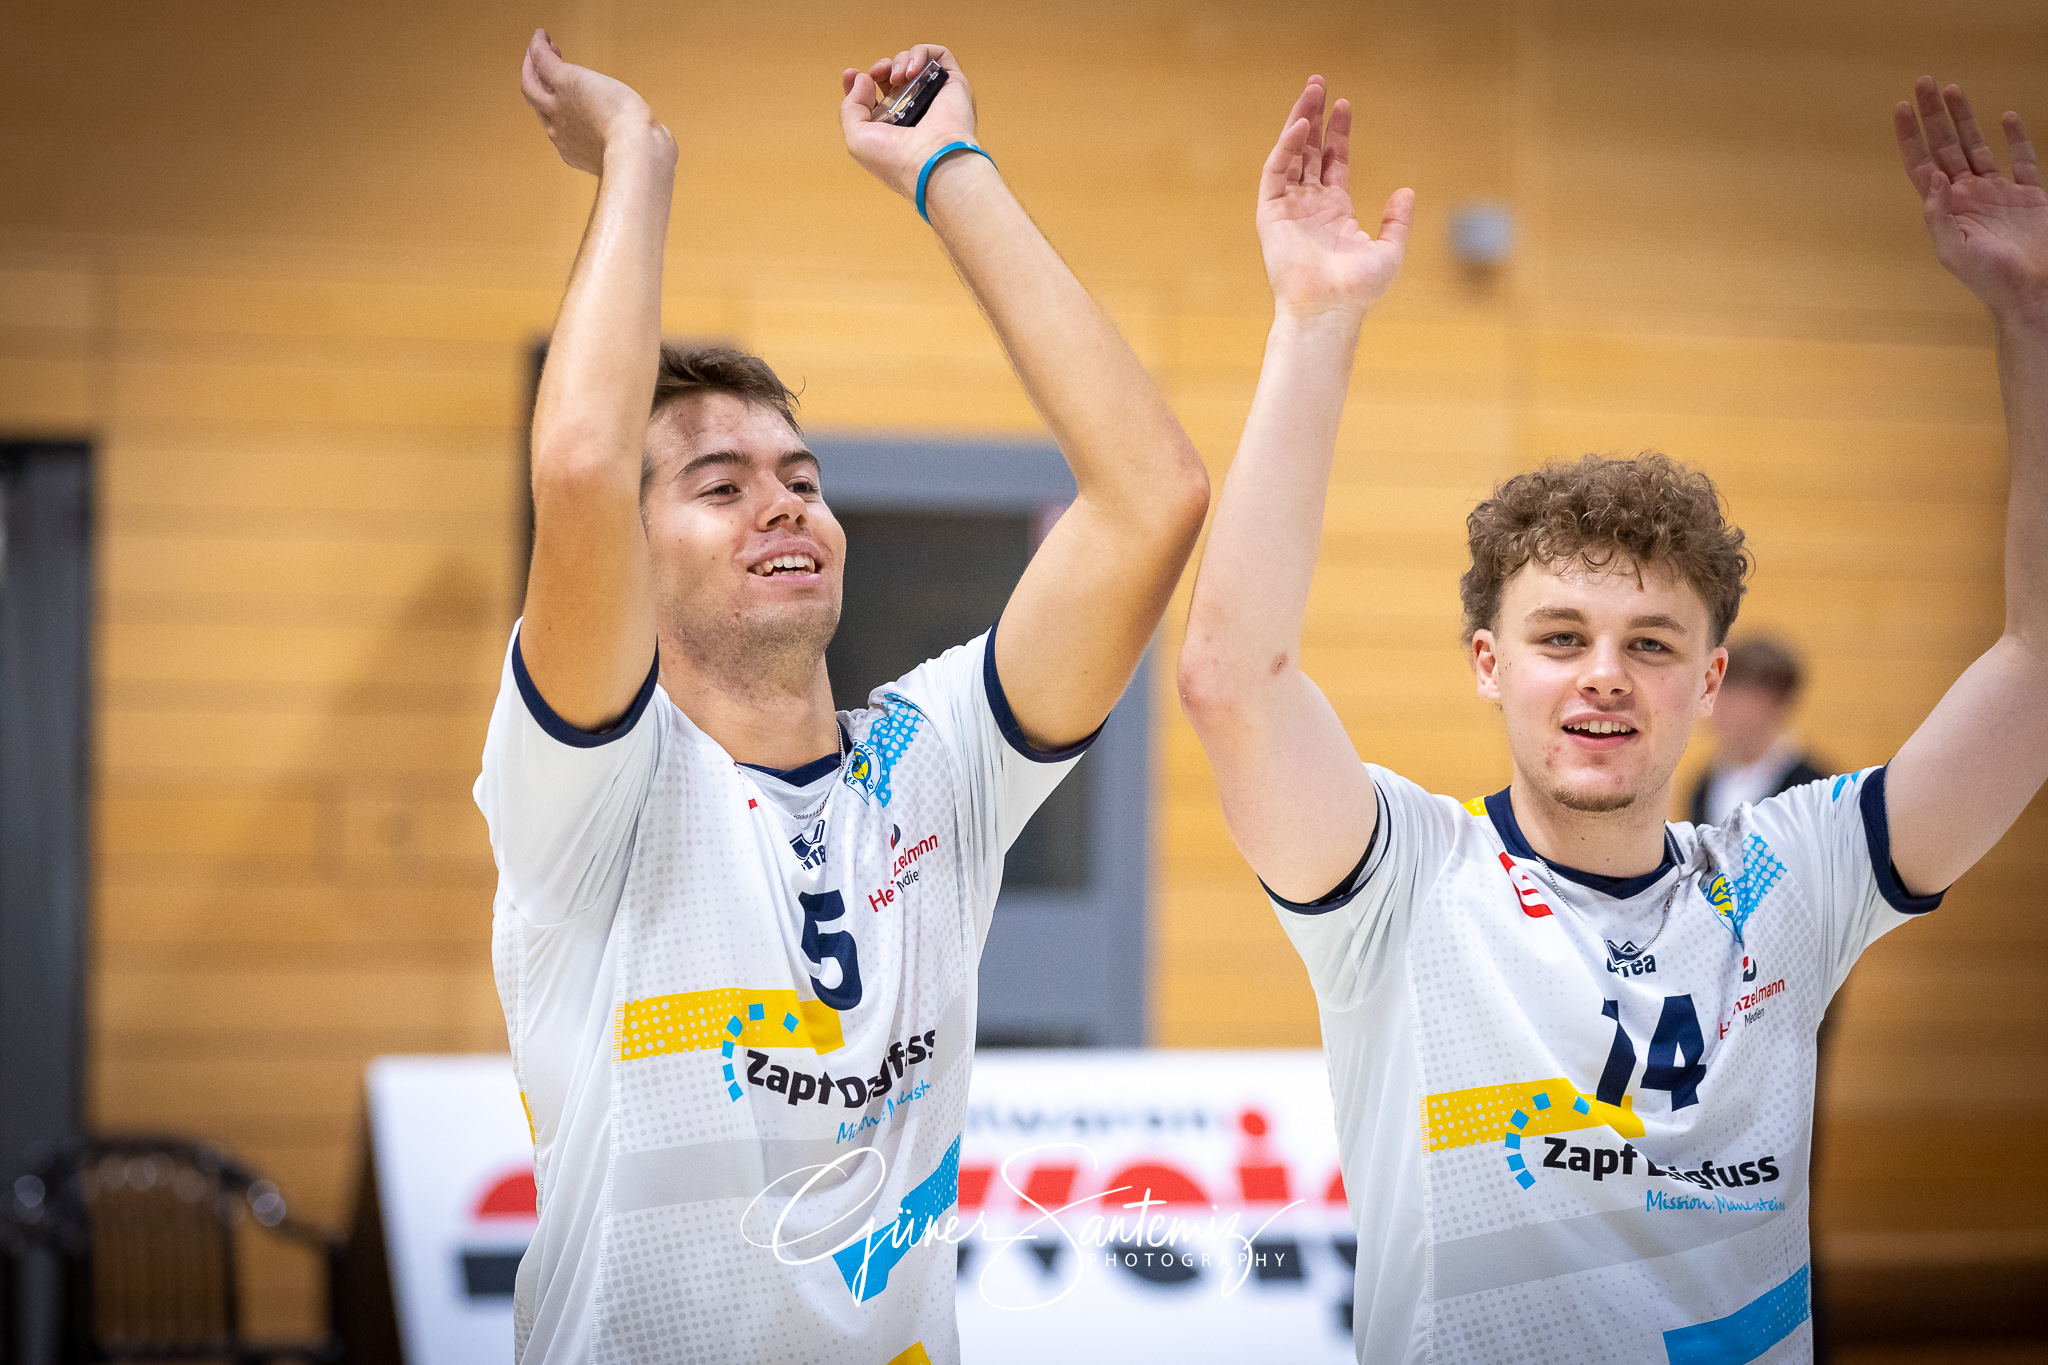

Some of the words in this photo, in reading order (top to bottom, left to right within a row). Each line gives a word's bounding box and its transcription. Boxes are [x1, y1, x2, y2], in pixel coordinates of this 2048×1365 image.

[798, 888, 862, 1011] 5
[1595, 993, 1707, 1113] 14
[1542, 1136, 1638, 1181] Zapf
